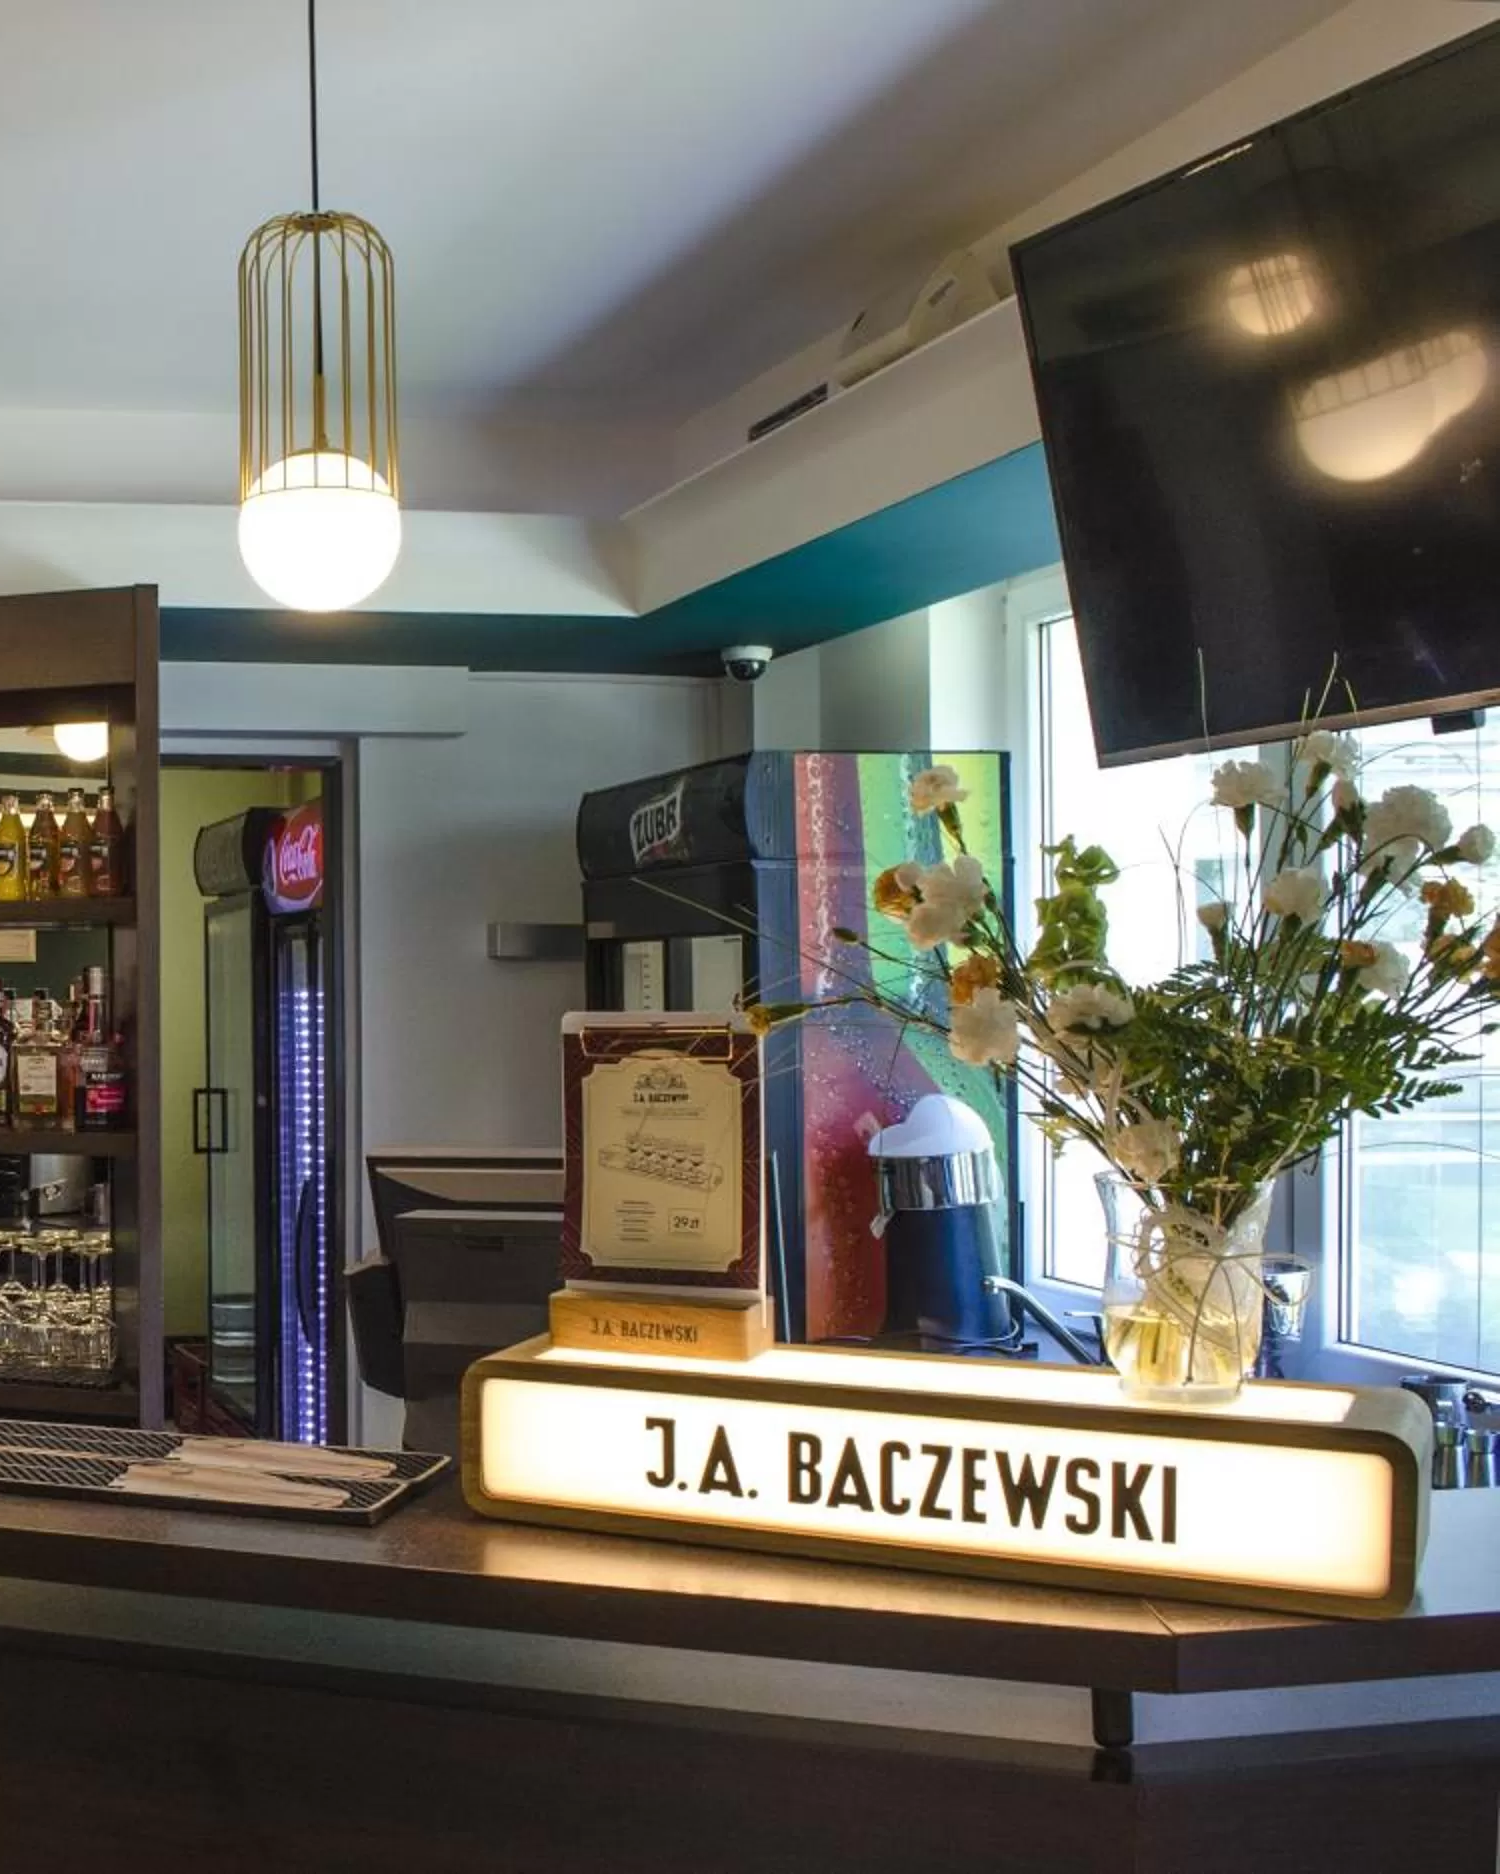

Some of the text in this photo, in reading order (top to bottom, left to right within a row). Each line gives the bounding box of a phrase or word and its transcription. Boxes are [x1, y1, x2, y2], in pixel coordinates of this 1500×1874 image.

[621, 1319, 699, 1344] BACZEWSKI
[644, 1417, 1178, 1545] J.A. BACZEWSKI
